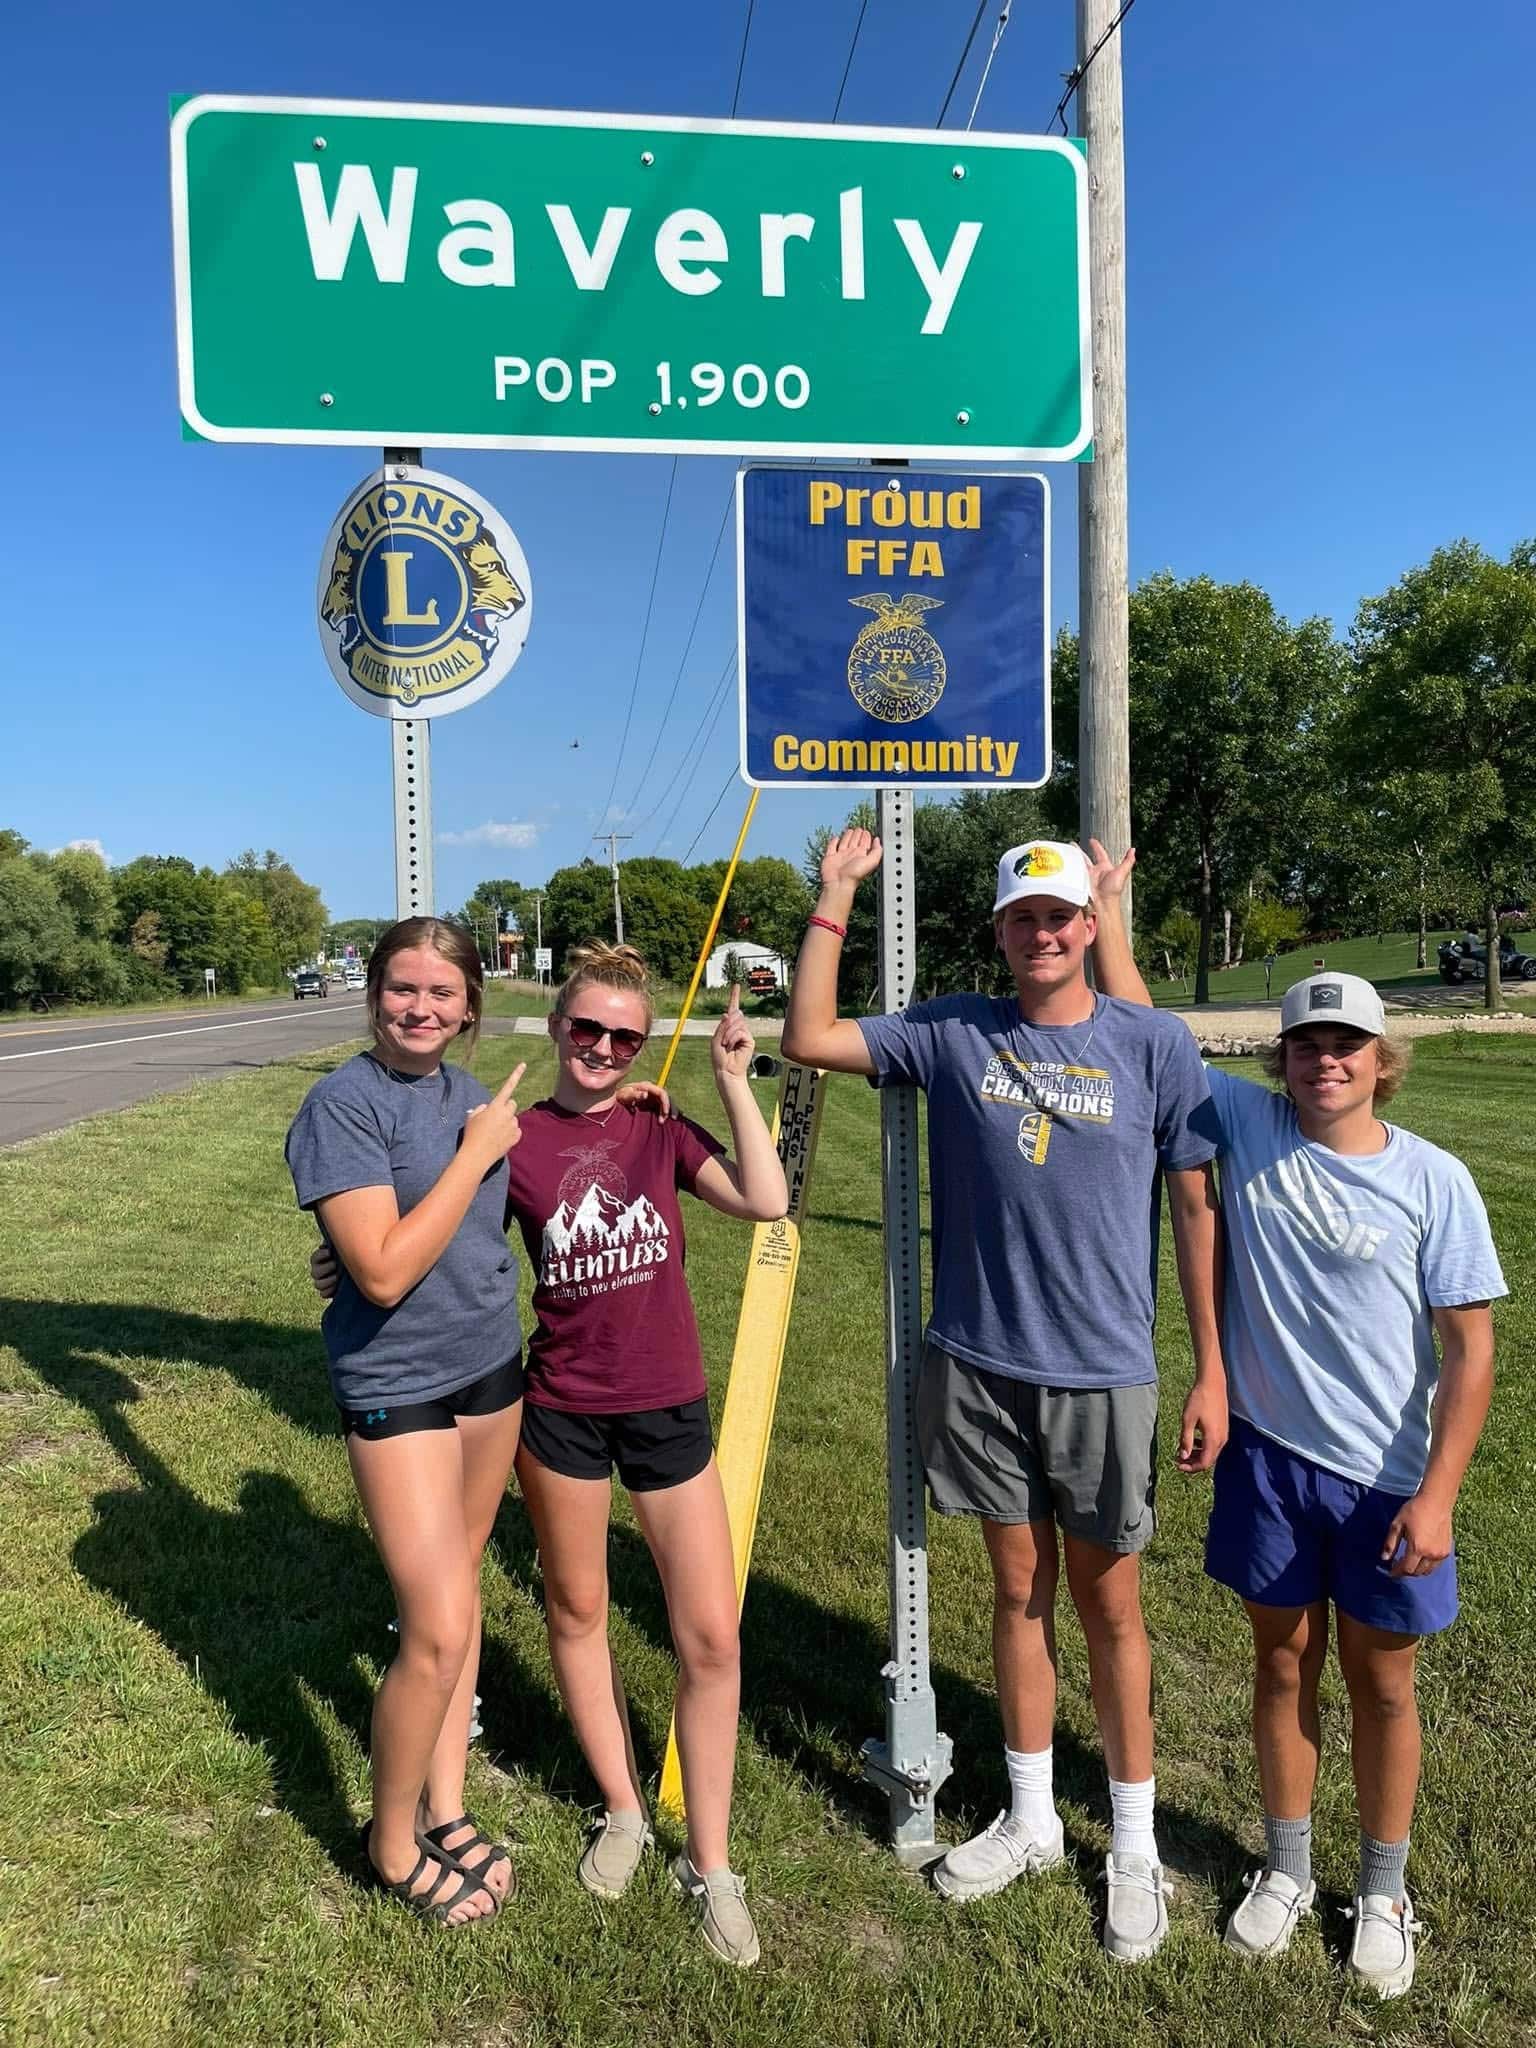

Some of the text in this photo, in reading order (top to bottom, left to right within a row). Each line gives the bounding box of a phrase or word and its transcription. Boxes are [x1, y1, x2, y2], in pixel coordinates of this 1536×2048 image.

[294, 162, 983, 335] Waverly
[494, 356, 810, 409] POP 1,900
[351, 489, 470, 542] LIONS
[810, 481, 981, 529] Proud
[847, 540, 945, 577] FFA
[380, 552, 440, 625] L
[880, 649, 916, 664] FFA
[869, 688, 927, 709] EDUCATION
[773, 734, 1020, 777] Community
[1030, 1061, 1066, 1074] 2022
[981, 1074, 1114, 1118] CHAMPIONS
[789, 1111, 804, 1159] GAS
[790, 1070, 819, 1203] PIPELINE
